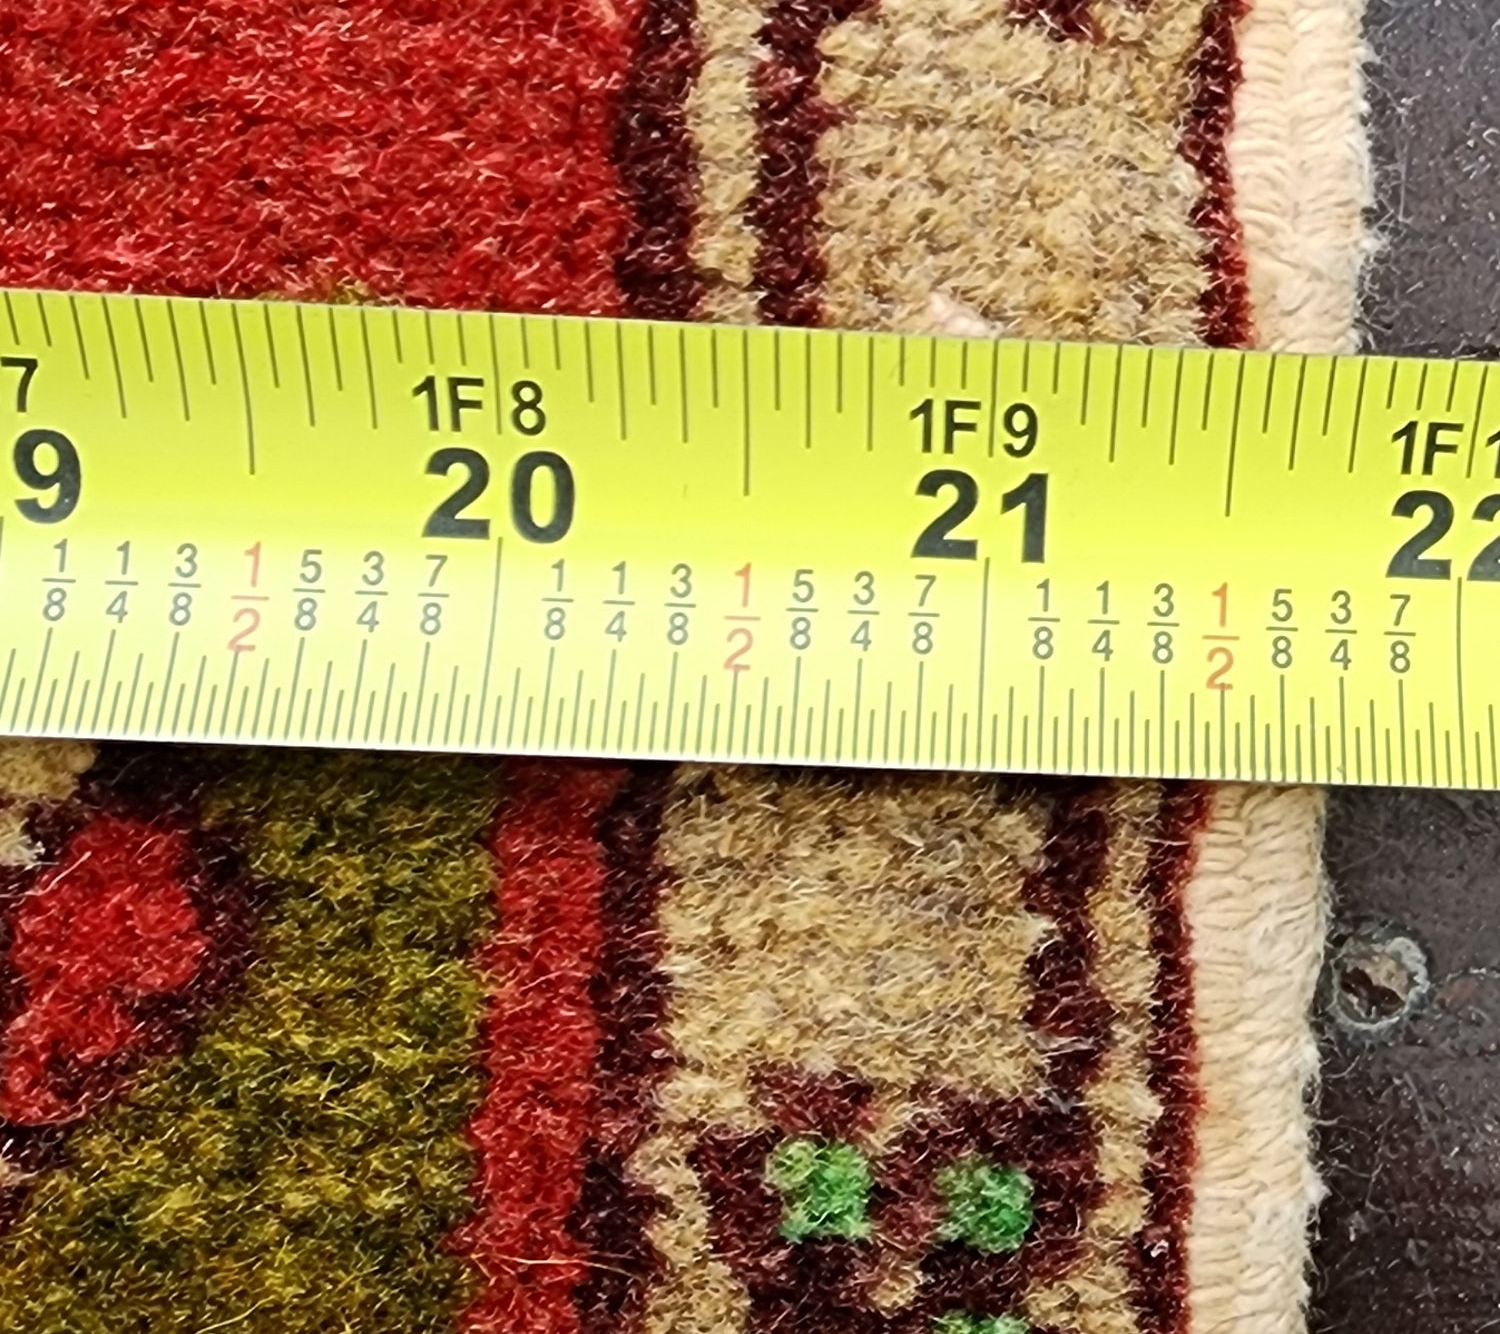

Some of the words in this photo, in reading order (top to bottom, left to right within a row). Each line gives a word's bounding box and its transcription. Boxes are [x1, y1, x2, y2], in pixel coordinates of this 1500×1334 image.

[411, 375, 485, 433] 1F
[511, 380, 547, 436] 8
[908, 398, 982, 454] 1F
[1002, 402, 1039, 458] 9
[1391, 420, 1465, 476] 1F
[421, 447, 576, 544] 20
[910, 468, 1049, 564] 21
